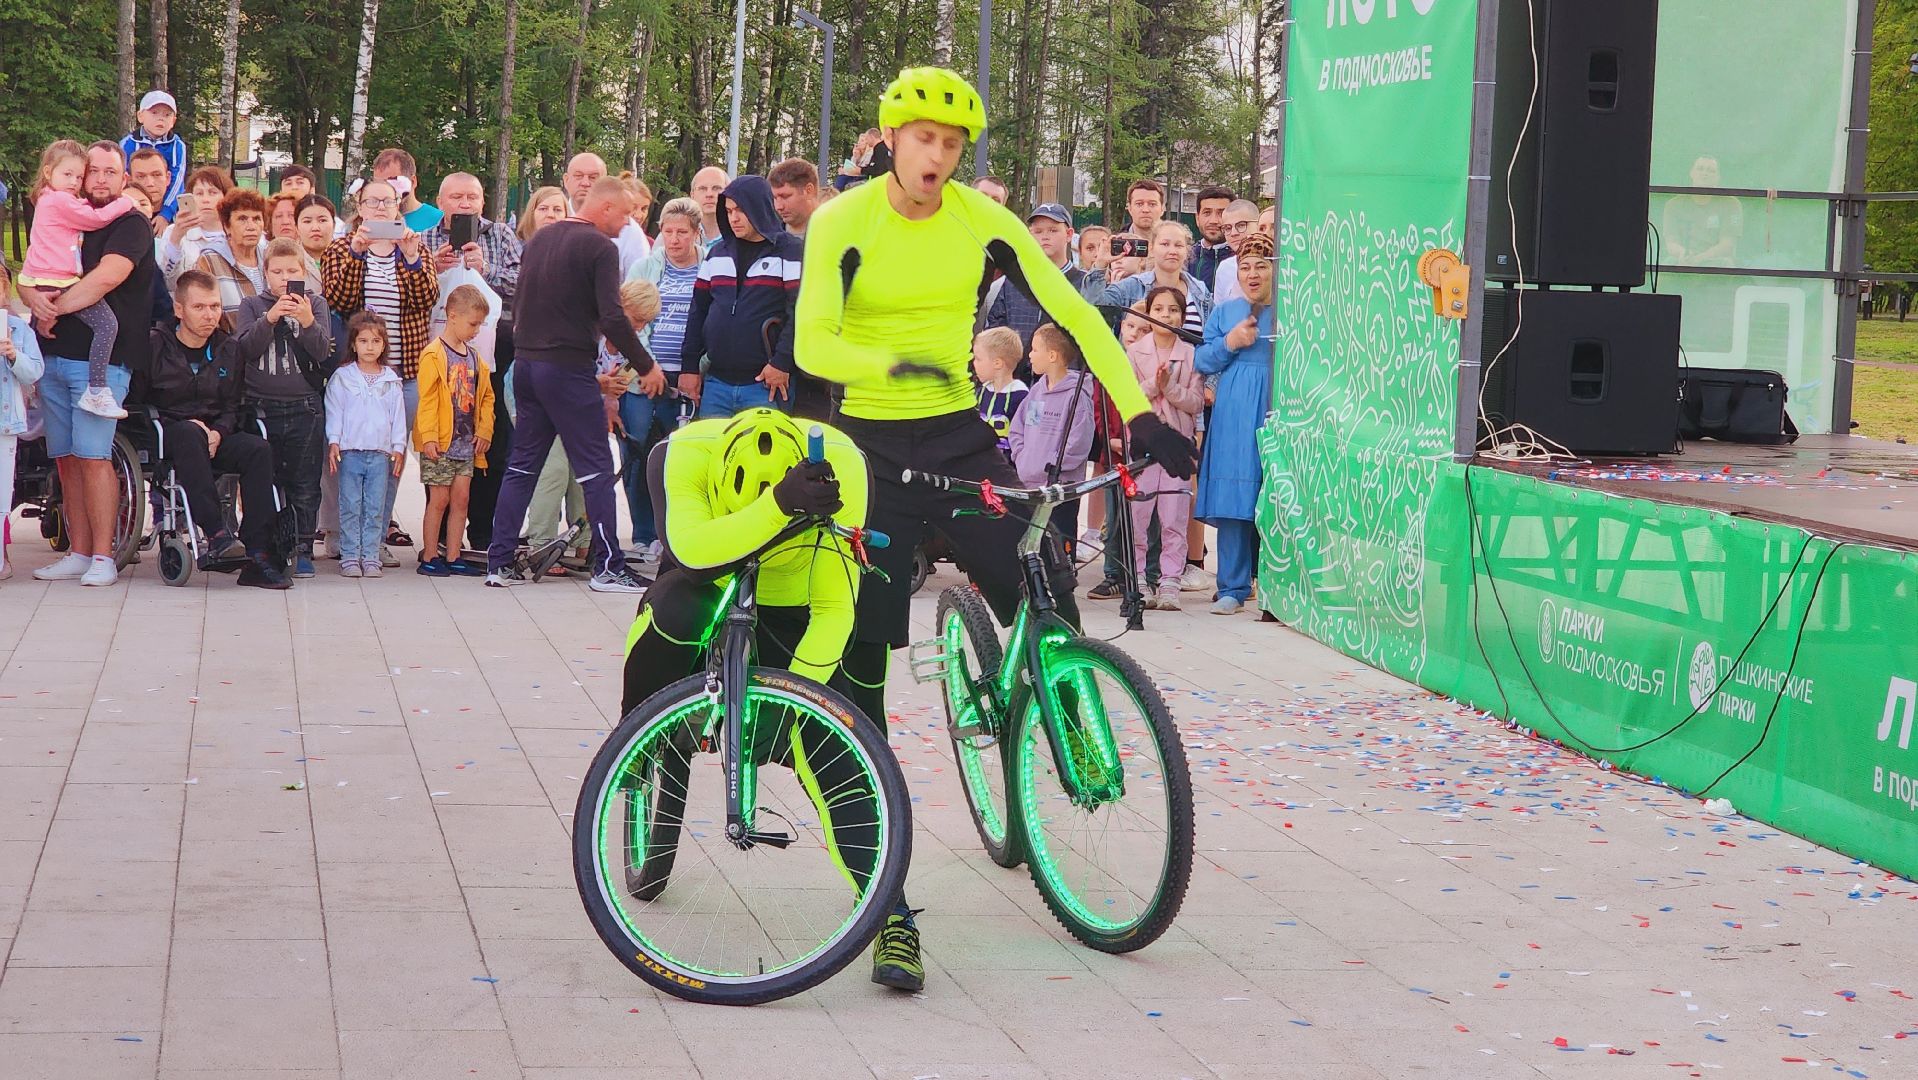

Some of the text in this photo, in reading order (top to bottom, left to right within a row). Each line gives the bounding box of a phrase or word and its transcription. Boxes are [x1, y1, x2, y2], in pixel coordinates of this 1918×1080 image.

[1318, 44, 1432, 97] В ПОДМОСКОВЬЕ
[1559, 607, 1605, 644] ПАРКИ
[1557, 640, 1665, 697] ПОДМОСКОВЬЯ
[1718, 691, 1756, 724] ПАРКИ
[1873, 766, 1883, 793] В
[634, 953, 706, 990] MAXXIS
